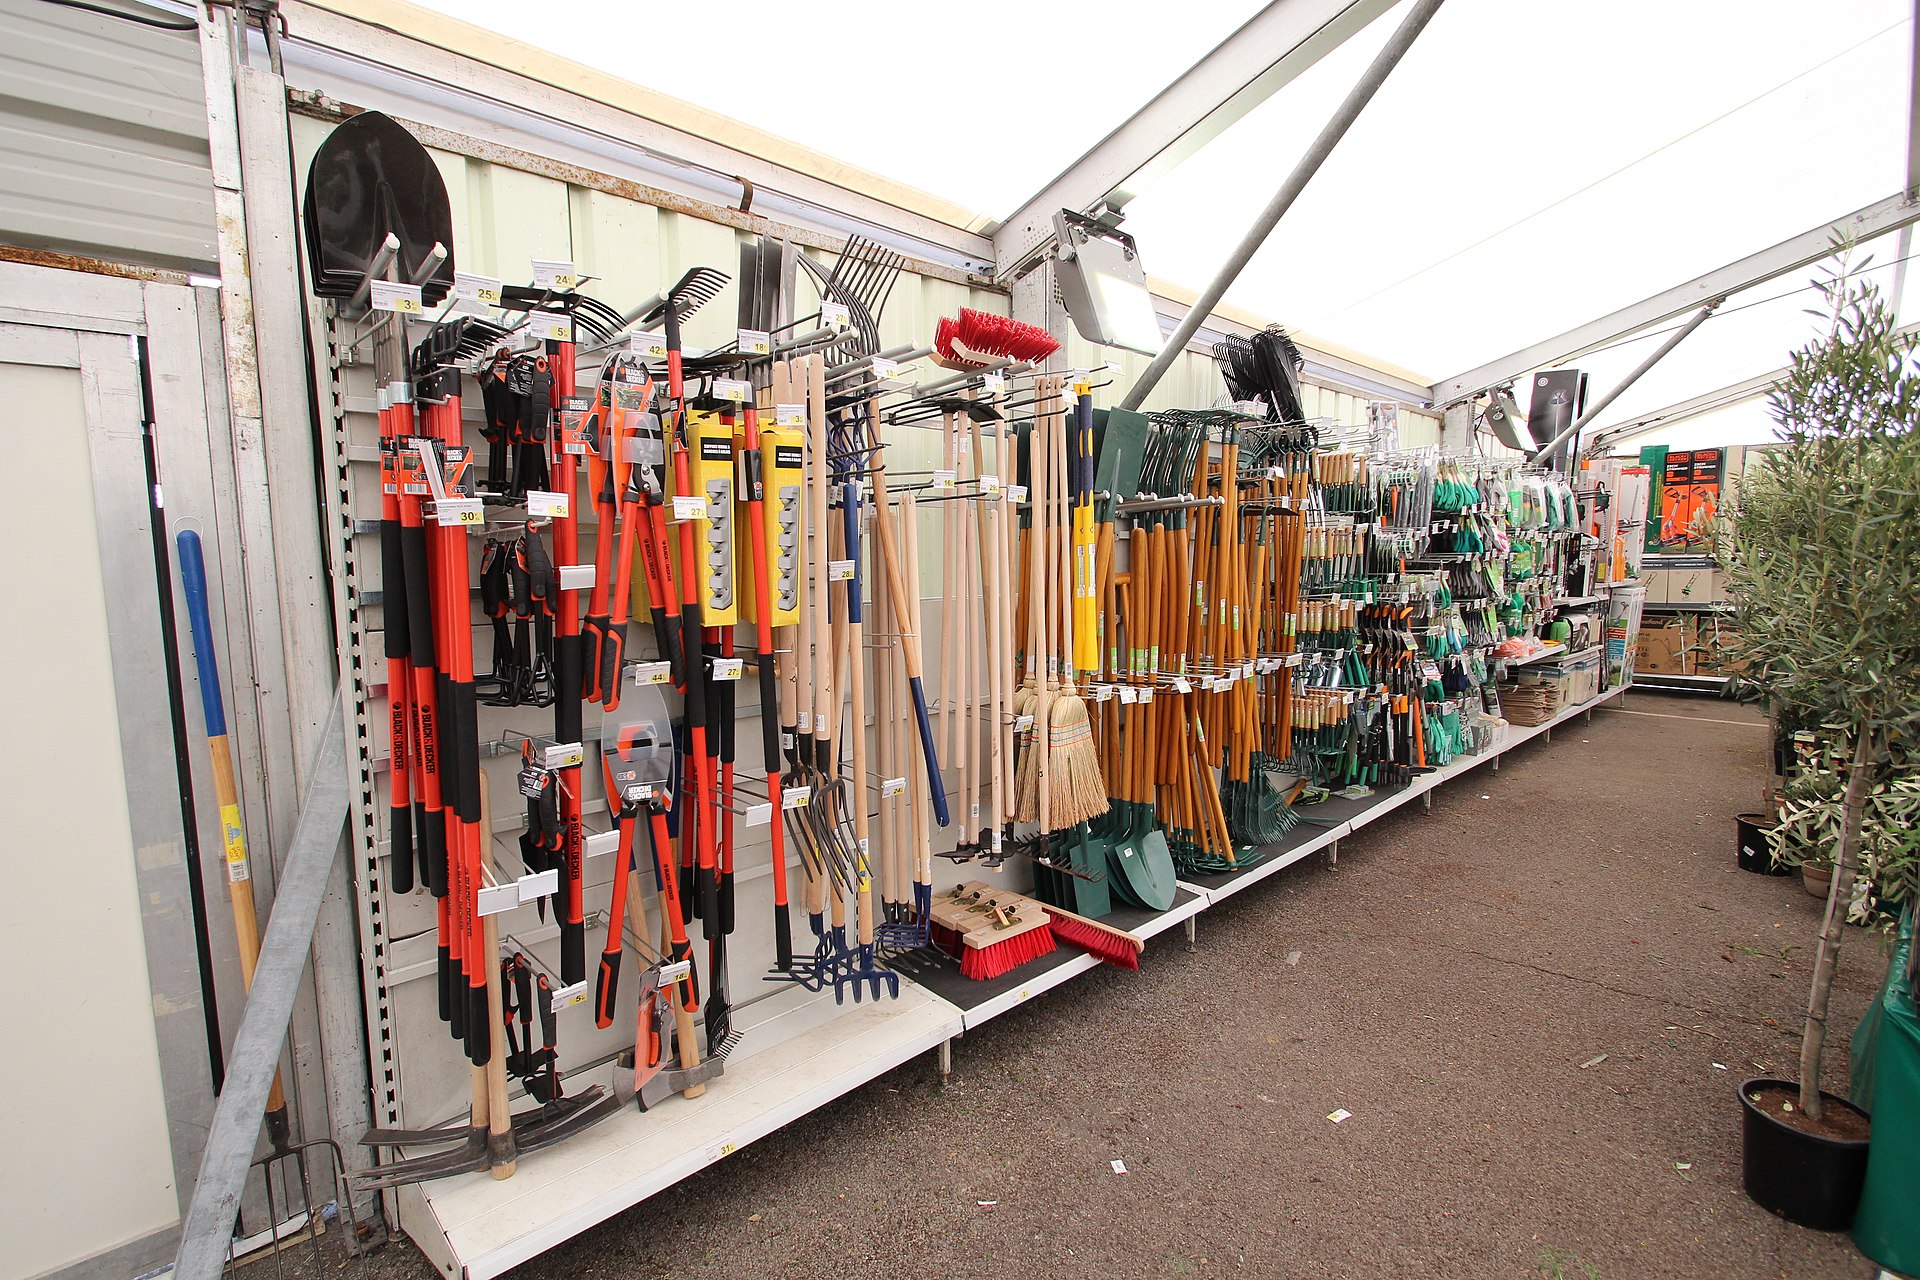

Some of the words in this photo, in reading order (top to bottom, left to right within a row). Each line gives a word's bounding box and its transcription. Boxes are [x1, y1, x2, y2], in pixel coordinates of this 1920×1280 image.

[556, 275, 567, 284] 24
[478, 288, 492, 300] 25
[836, 314, 844, 322] 27
[649, 346, 660, 354] 42
[755, 343, 764, 351] 18
[690, 508, 700, 516] 27
[460, 512, 474, 521] 30
[720, 1144, 730, 1154] 31
